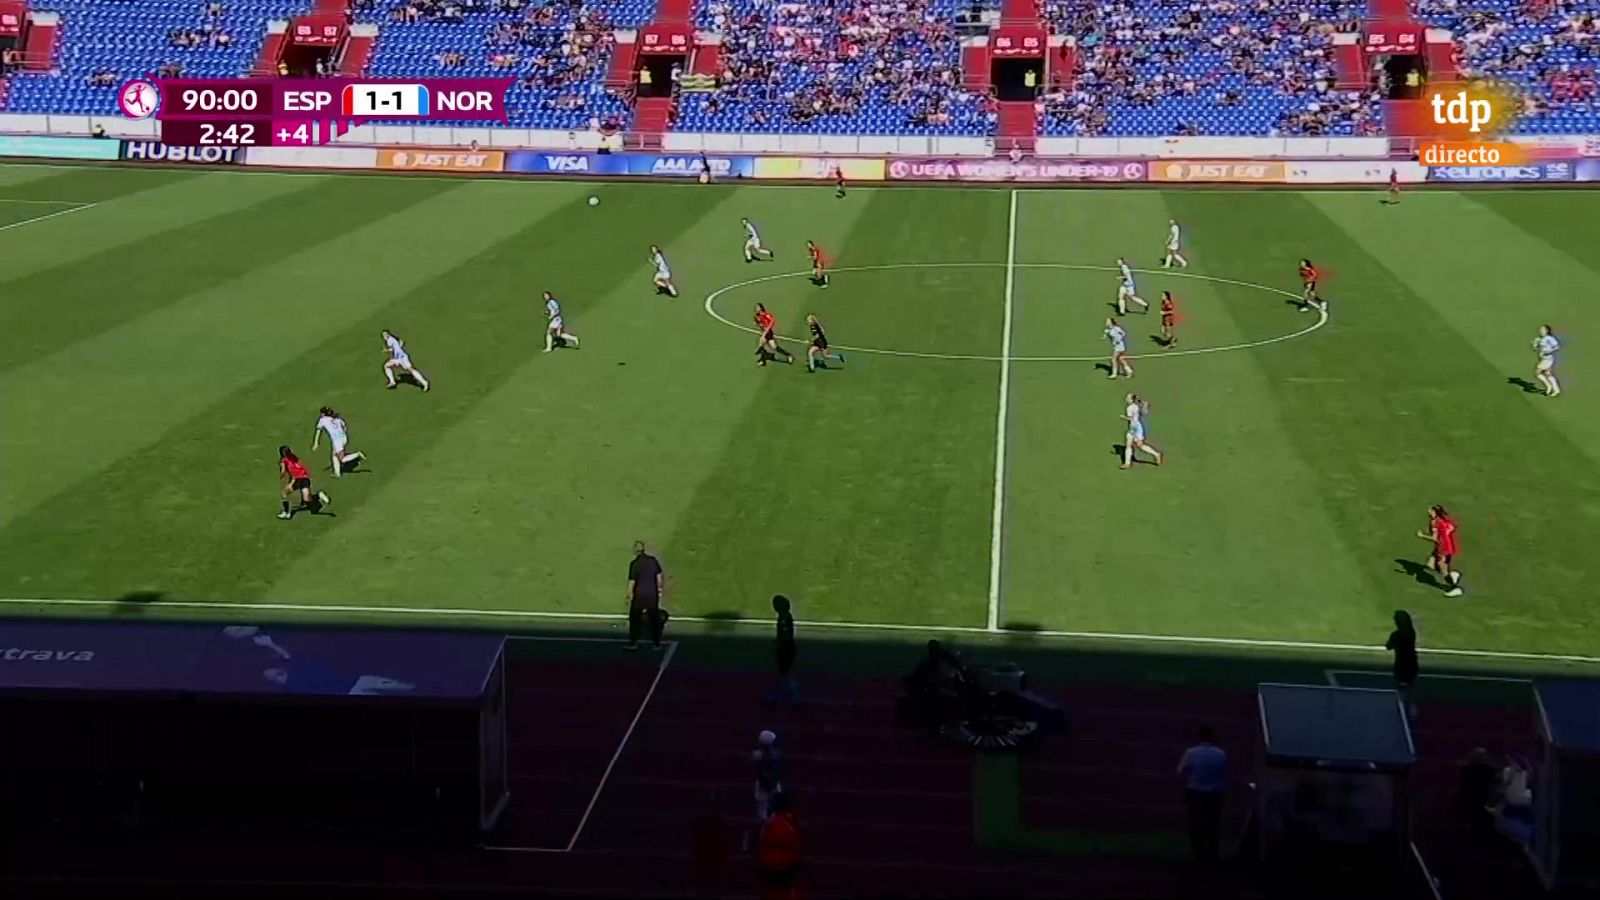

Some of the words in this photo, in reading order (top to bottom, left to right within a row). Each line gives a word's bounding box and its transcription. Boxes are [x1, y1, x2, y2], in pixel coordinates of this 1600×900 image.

[126, 141, 239, 162] HUBLOT
[411, 153, 453, 167] JUST
[454, 154, 488, 167] EAT
[544, 156, 589, 171] VISA
[653, 158, 686, 170] AAA
[911, 164, 956, 176] UEFA
[1039, 164, 1119, 177] UNDER-19
